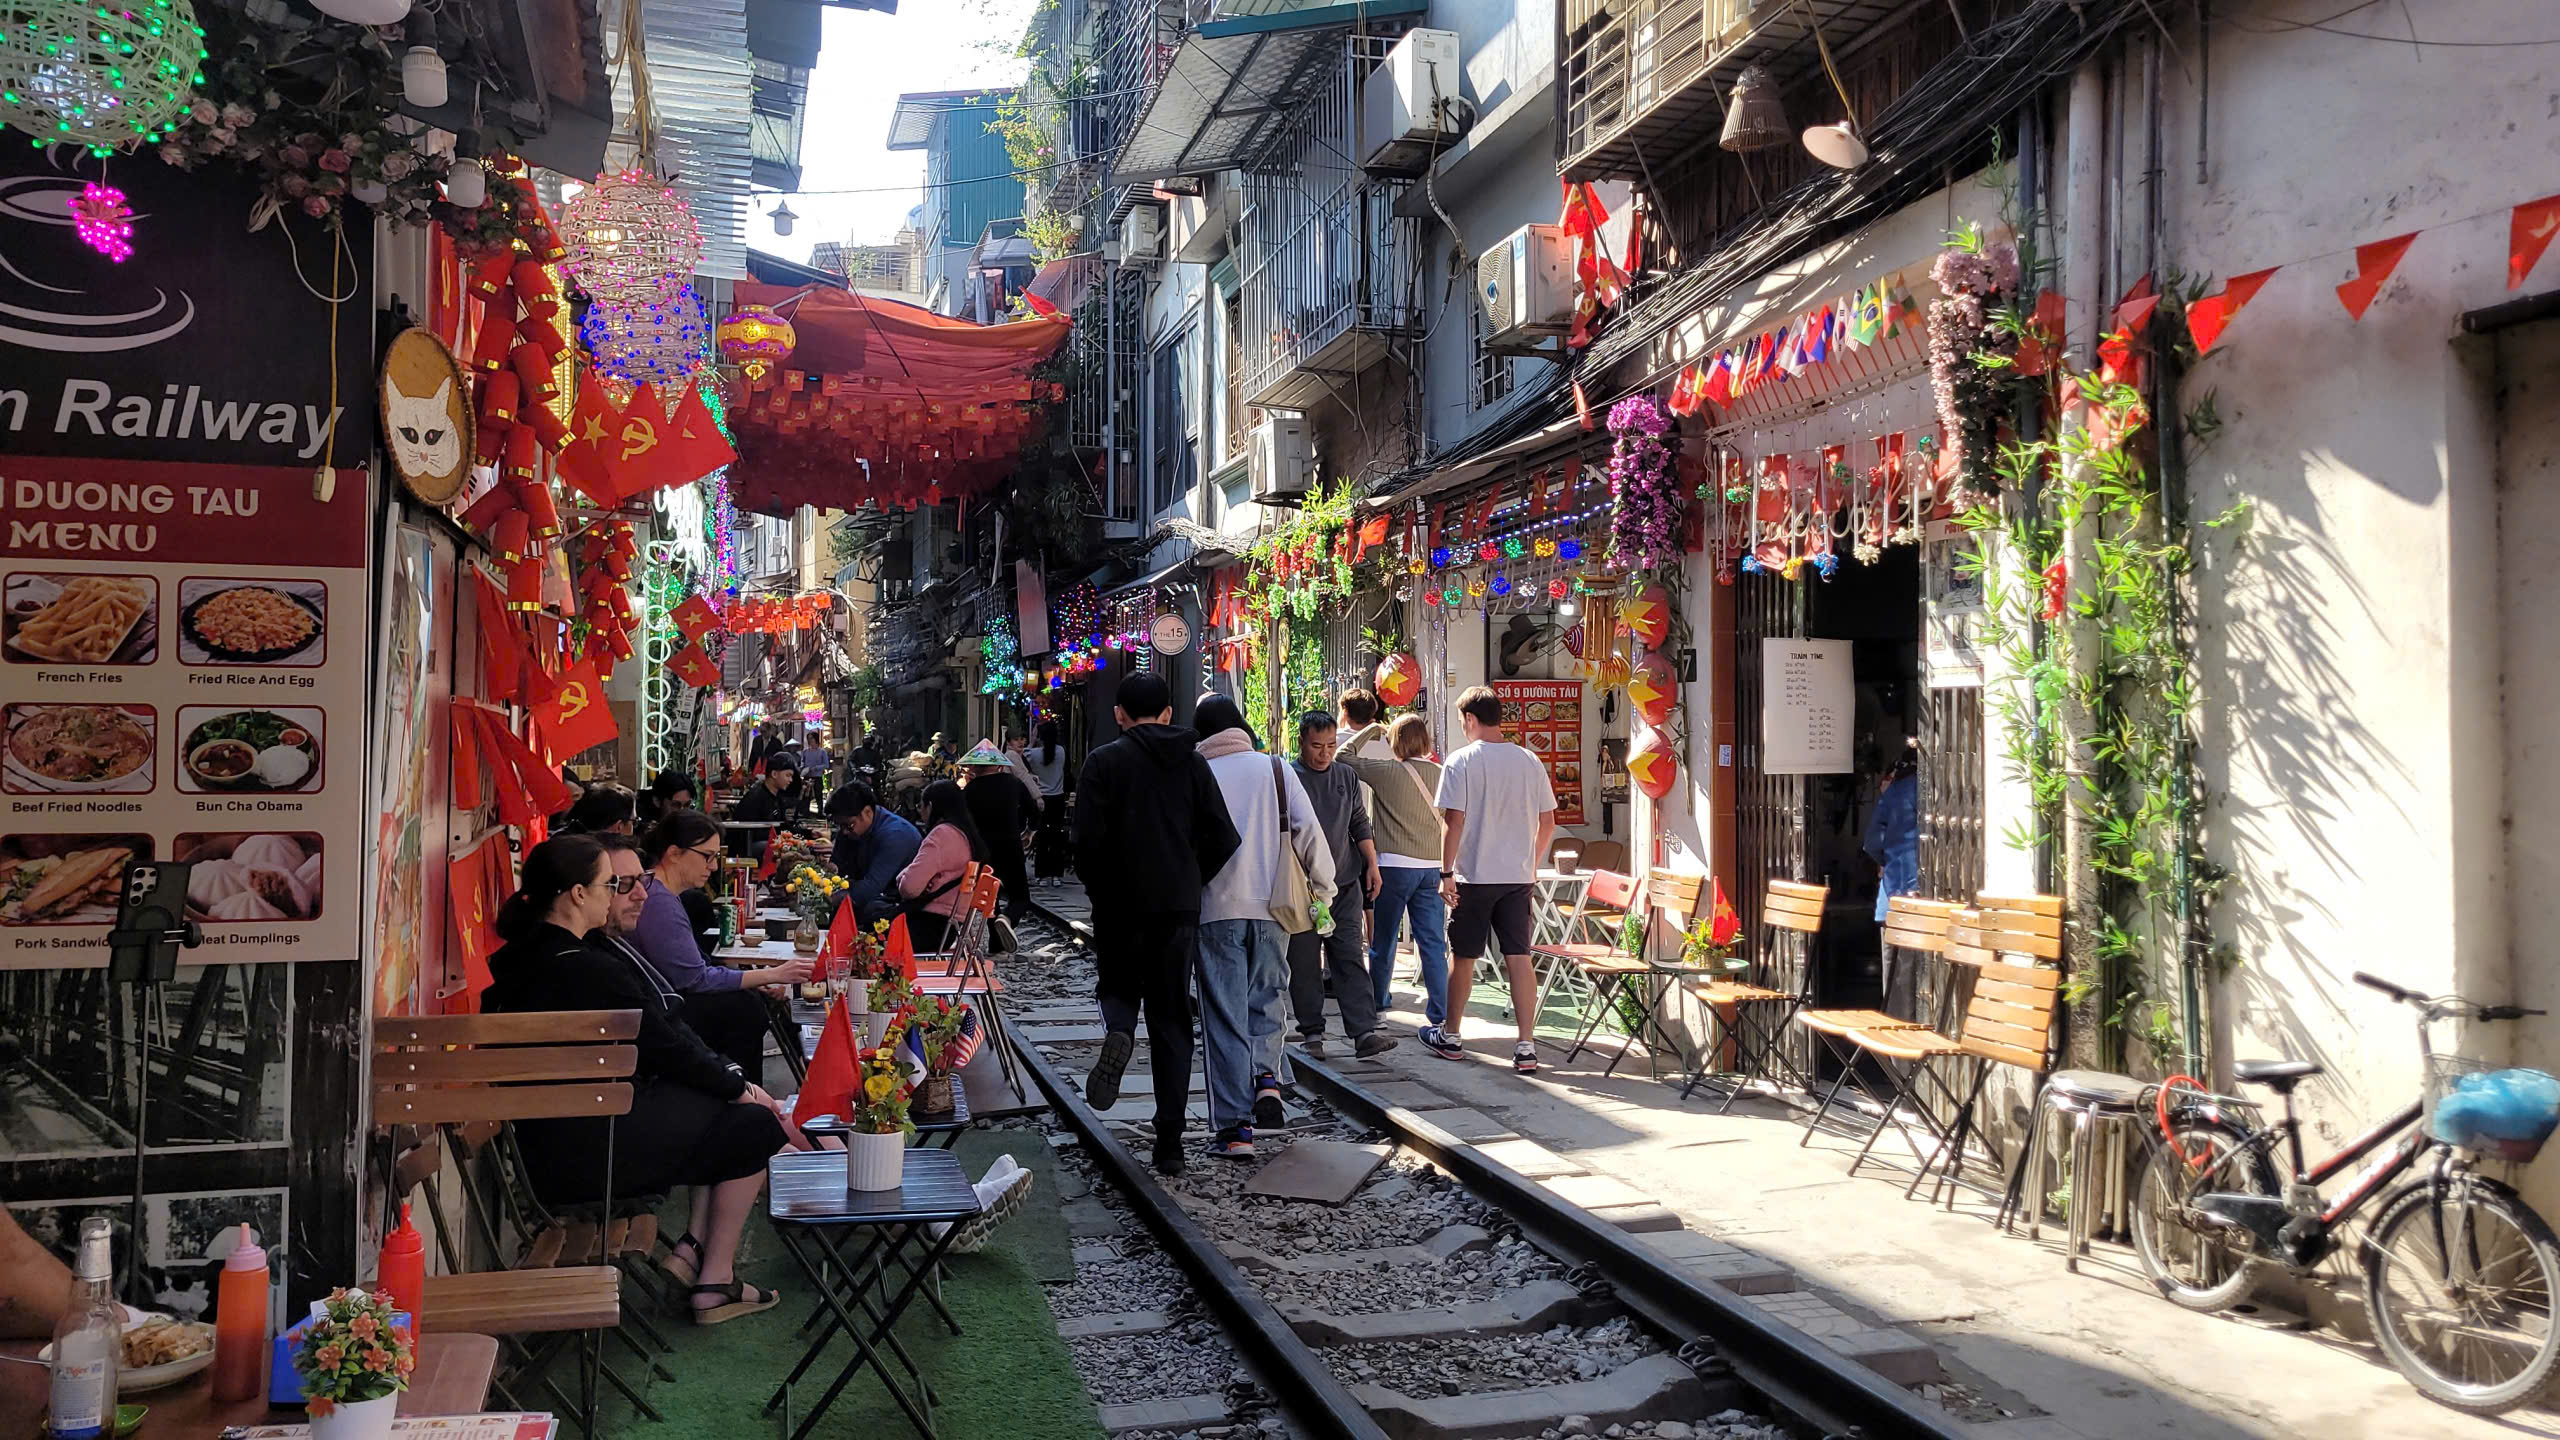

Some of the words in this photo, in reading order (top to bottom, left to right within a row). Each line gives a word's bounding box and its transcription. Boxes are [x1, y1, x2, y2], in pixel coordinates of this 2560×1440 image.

[54, 378, 344, 459] Railway
[15, 479, 174, 514] DUONG
[187, 486, 259, 517] TAU
[8, 520, 157, 552] MENU
[1171, 627, 1183, 638] 15
[1790, 652, 1807, 660] TRAIN
[37, 671, 85, 683] French
[89, 672, 123, 683] Fries
[188, 674, 222, 685] Fried
[226, 674, 256, 685] Rice
[258, 675, 286, 686] And
[289, 675, 315, 688] Egg
[1498, 684, 1511, 698] SỐ
[1514, 687, 1520, 698] 9
[1559, 685, 1578, 698] TÀU
[12, 802, 43, 813] Beef
[48, 801, 82, 813] Fried
[87, 801, 143, 813] Noodles
[196, 801, 223, 812] Bun
[226, 801, 253, 812] Cha
[256, 801, 303, 812] Obama
[15, 938, 47, 949] Pork
[51, 937, 110, 949] Sandwic
[230, 933, 300, 946] Dumplings
